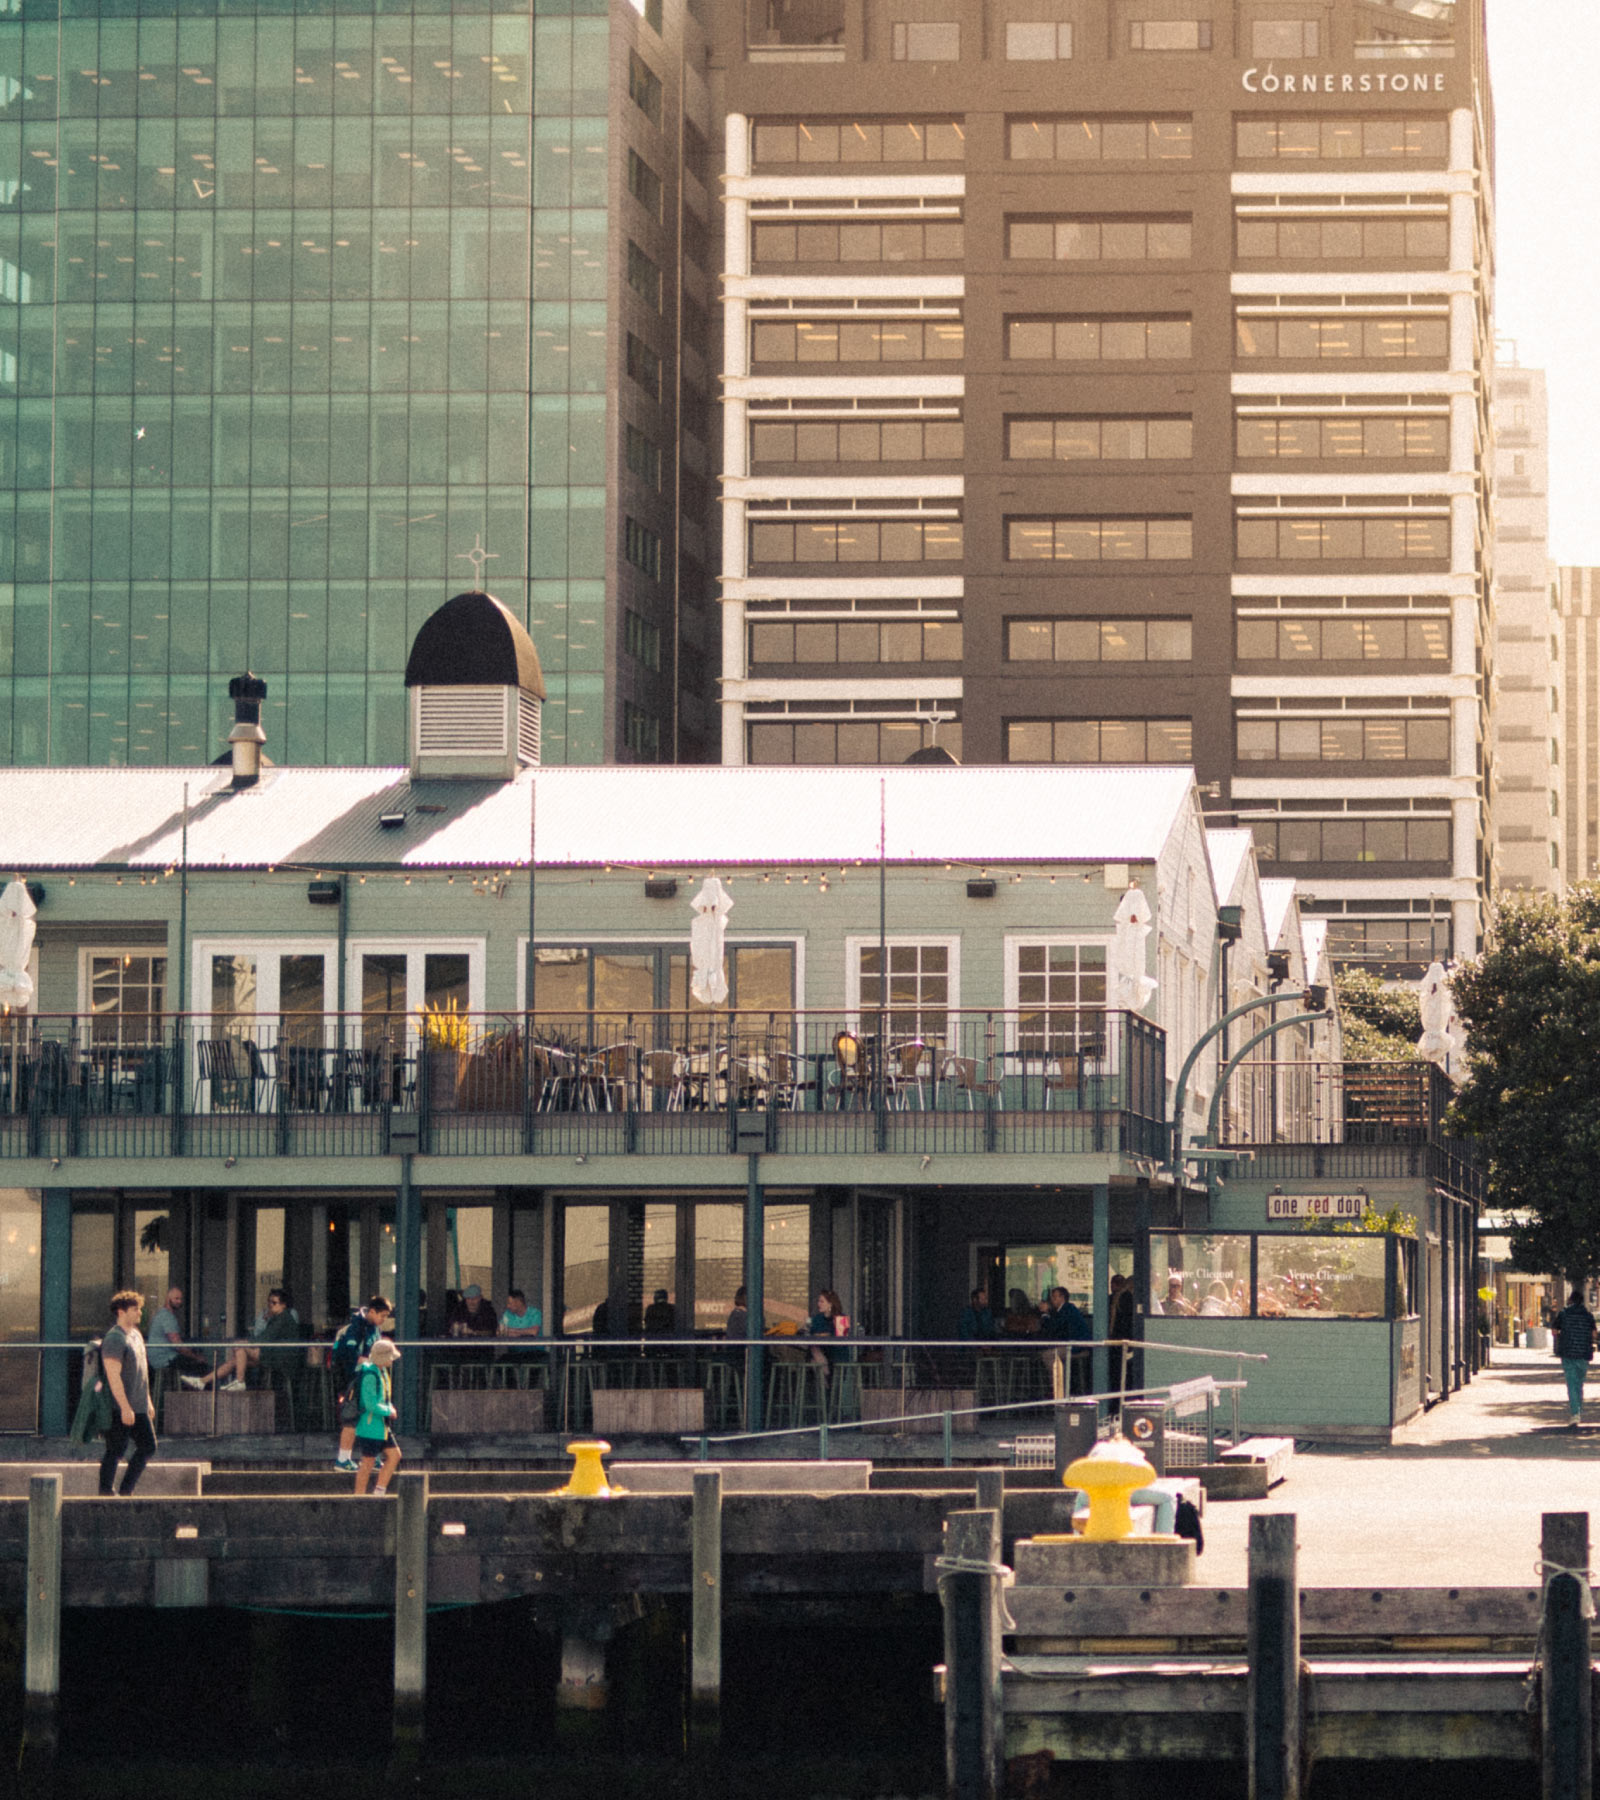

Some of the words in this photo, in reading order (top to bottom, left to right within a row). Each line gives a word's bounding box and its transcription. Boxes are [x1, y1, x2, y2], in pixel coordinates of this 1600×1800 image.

[1241, 65, 1446, 93] CORNERSTONE
[1274, 1199, 1298, 1214] one
[1307, 1196, 1329, 1214] red
[1337, 1196, 1361, 1217] dog
